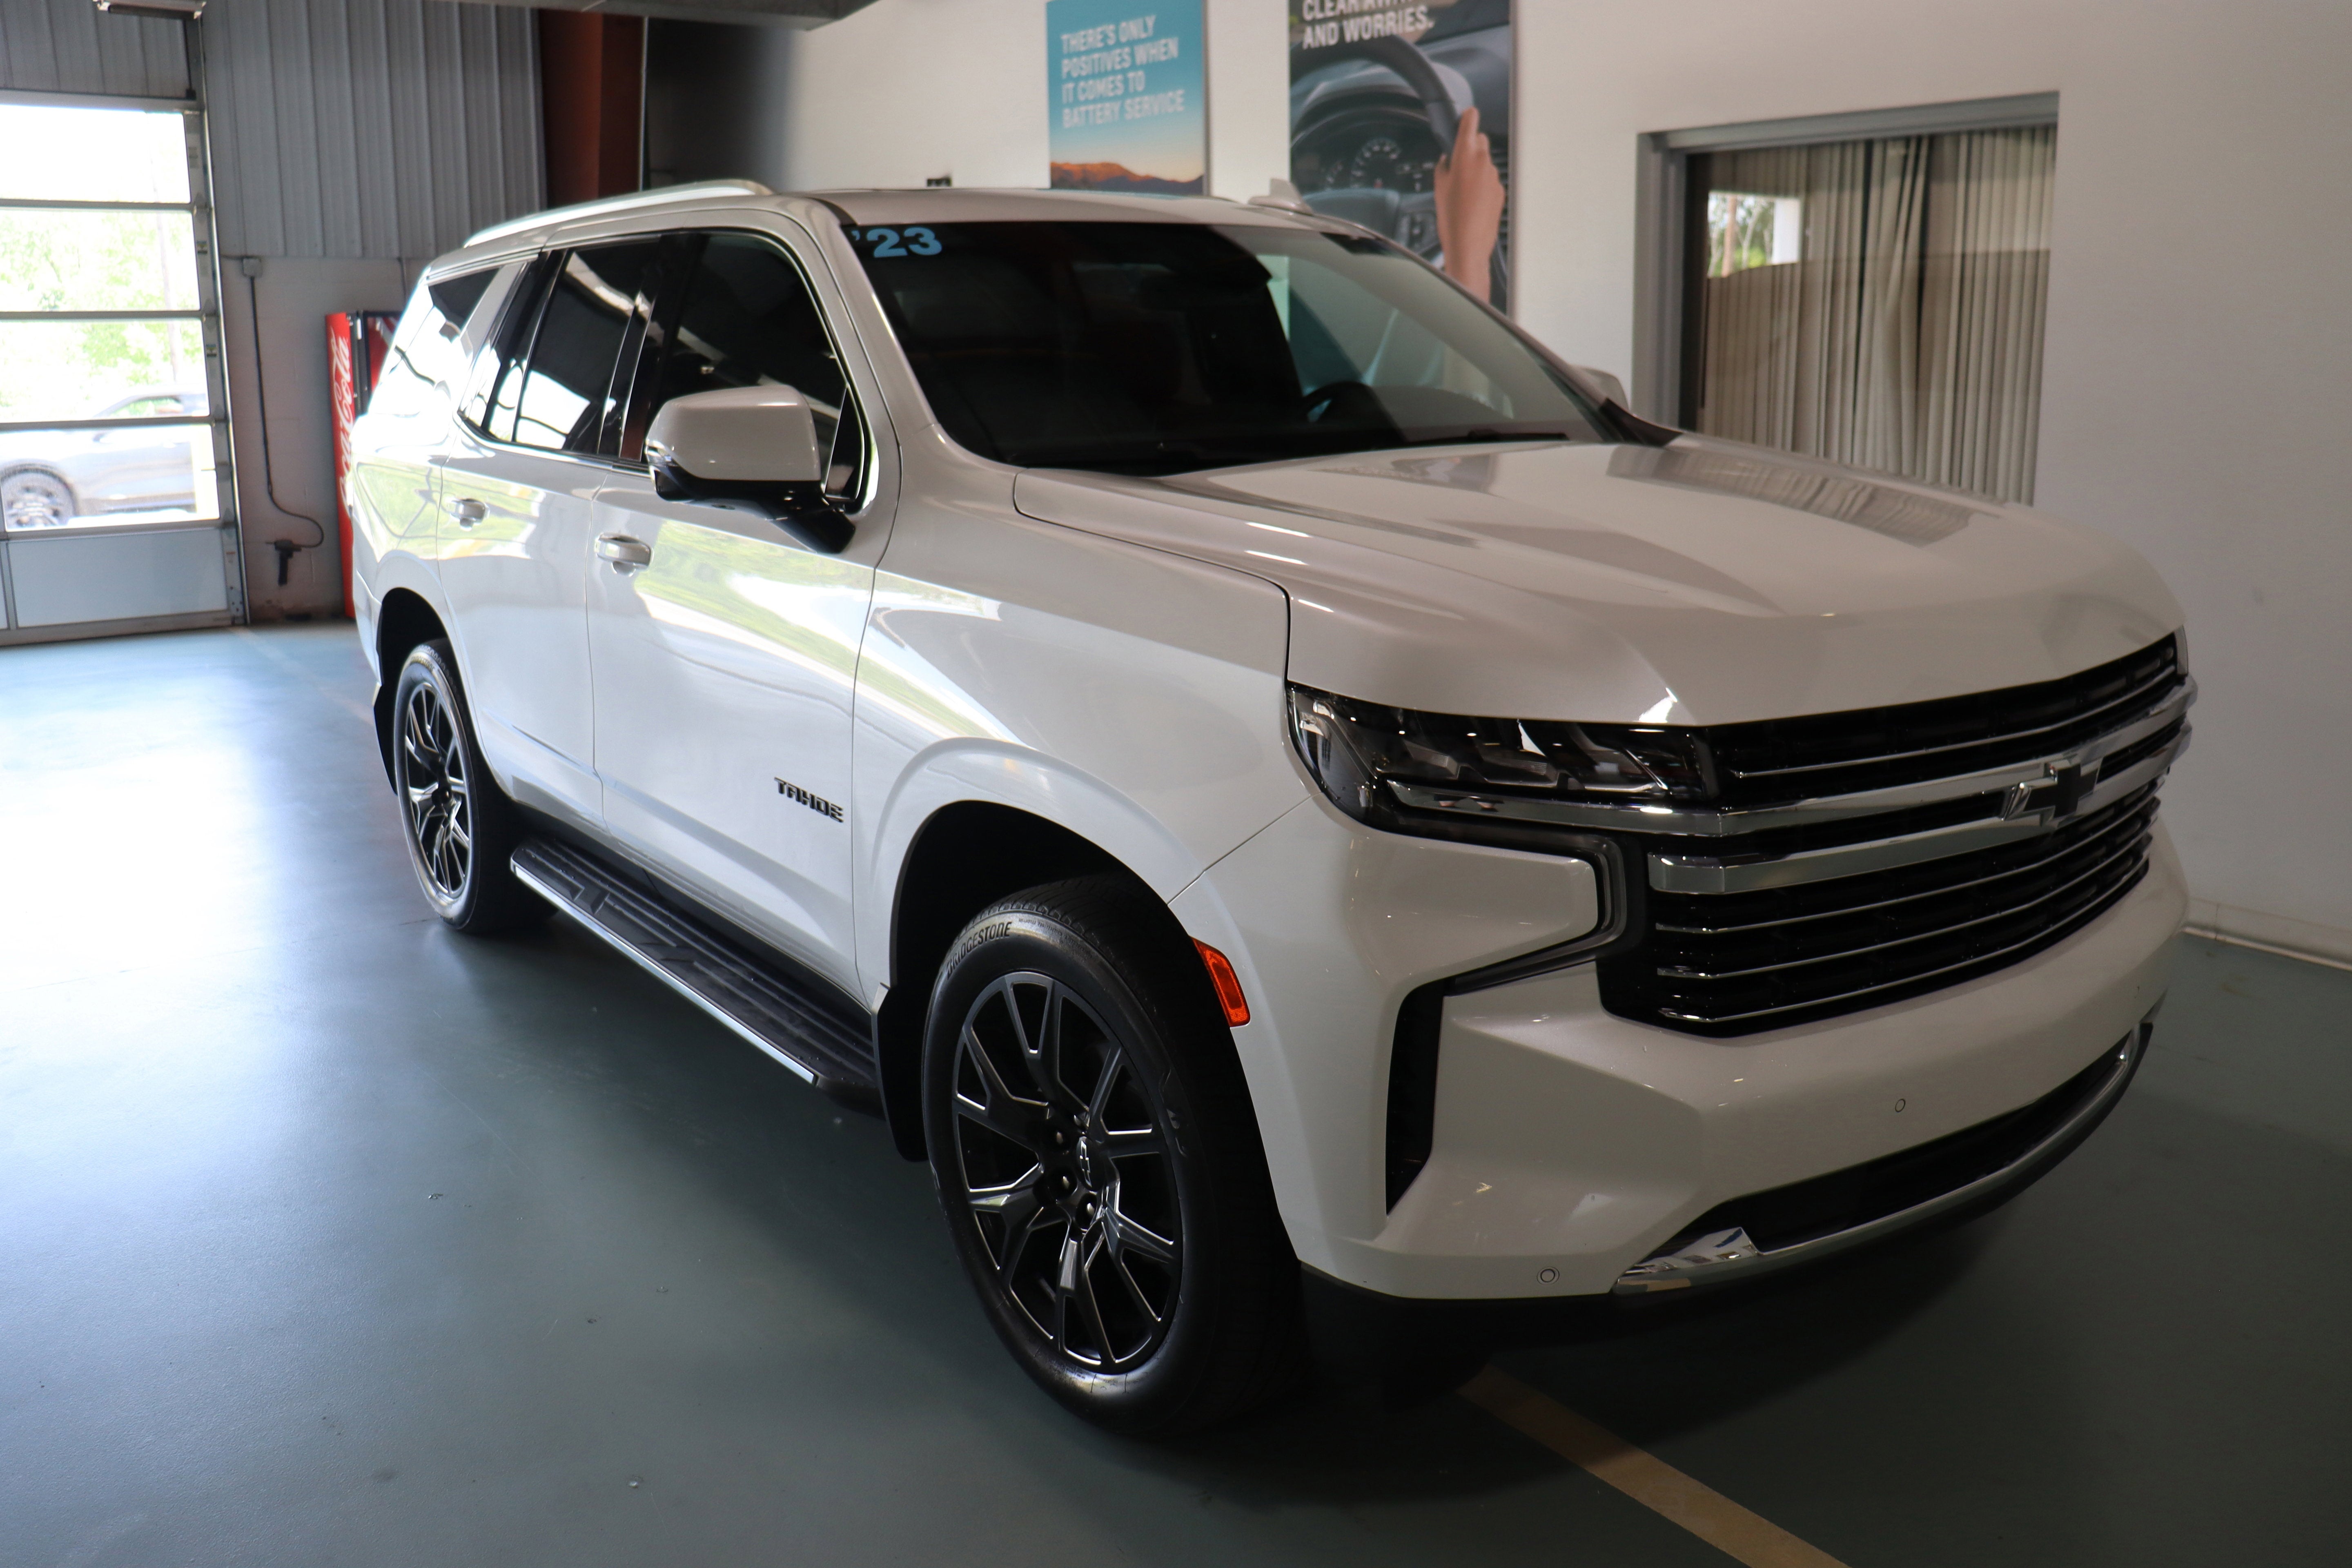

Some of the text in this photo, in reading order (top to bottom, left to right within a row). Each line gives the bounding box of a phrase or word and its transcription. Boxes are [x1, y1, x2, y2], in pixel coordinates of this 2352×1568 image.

[1061, 15, 1156, 54] THERE'S ONLY
[1302, 5, 1435, 50] AND WORRIES.
[1062, 37, 1179, 79] POSITIVES WHEN
[1062, 70, 1146, 104] IT COMES TO
[1062, 89, 1185, 129] BATTERY SERVICE
[330, 325, 354, 517] ca-Cola
[774, 777, 844, 823] TAHOE
[947, 921, 1012, 980] BRIDGESTONE
